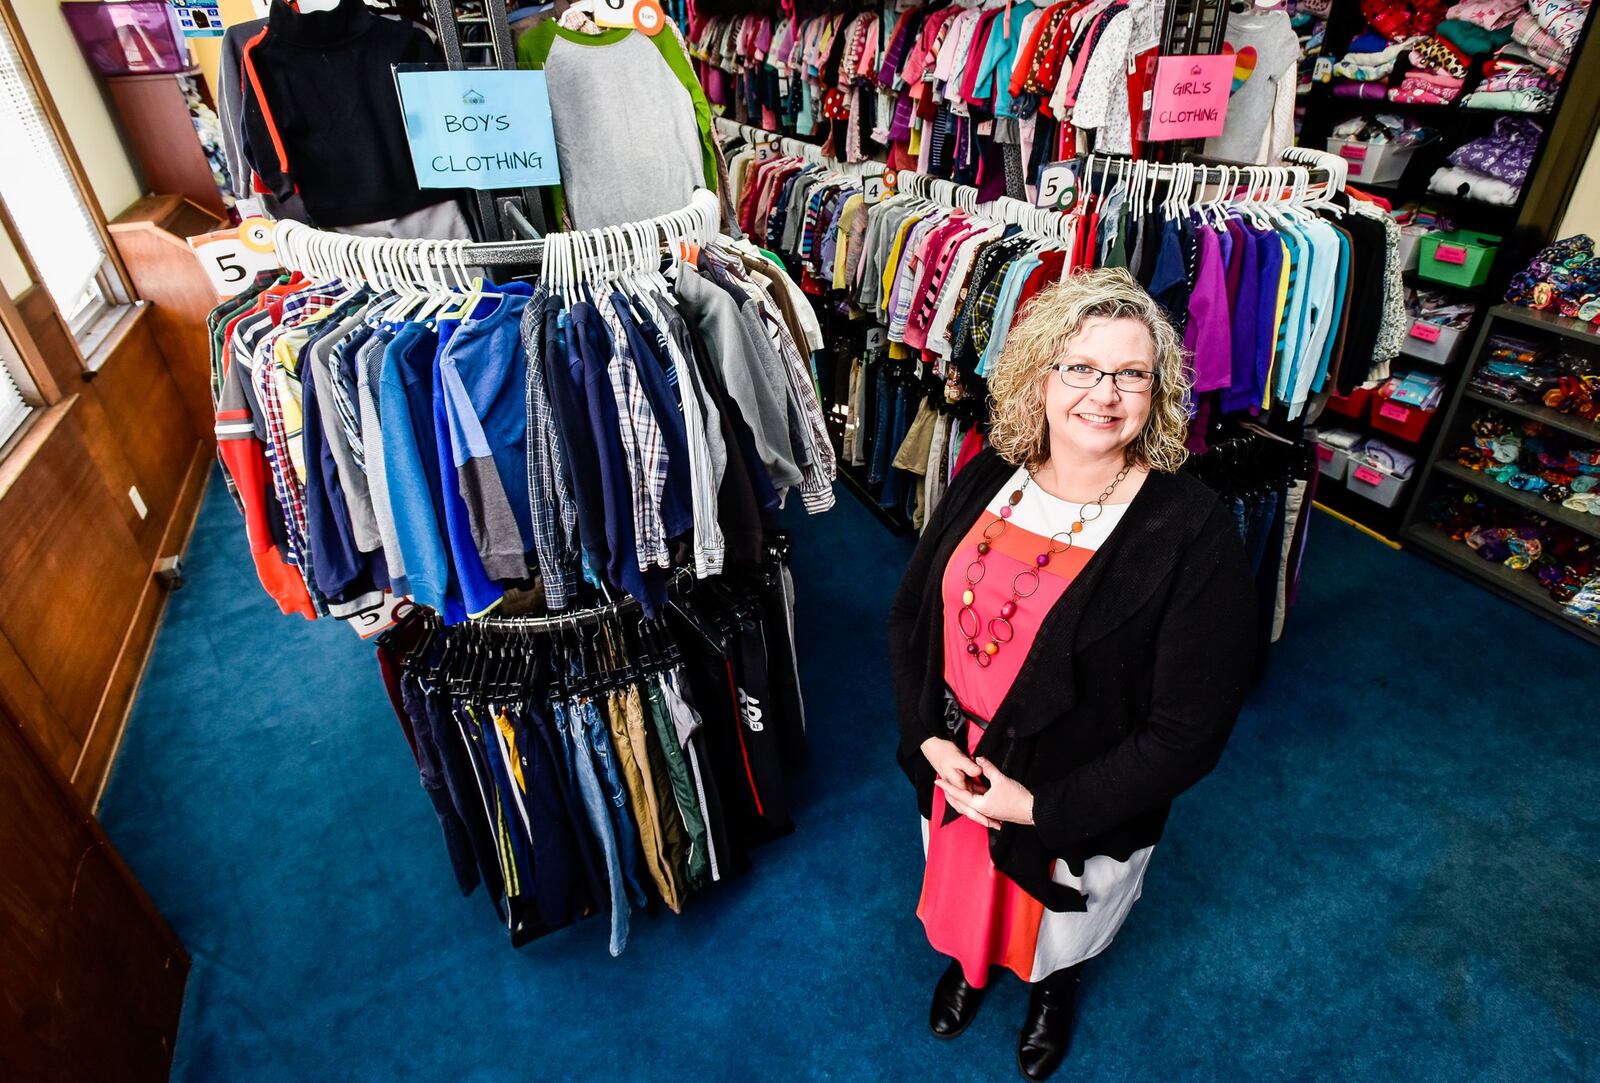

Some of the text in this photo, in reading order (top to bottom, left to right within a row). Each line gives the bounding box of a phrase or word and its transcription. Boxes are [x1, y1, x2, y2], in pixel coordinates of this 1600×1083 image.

[1172, 81, 1212, 96] GIRL'S
[444, 114, 510, 133] BOY'S
[1159, 108, 1218, 124] CLOTHING
[432, 151, 543, 172] CLOTHING
[759, 149, 767, 160] 3
[868, 183, 879, 198] 4
[1044, 176, 1059, 197] 5
[254, 229, 264, 240] 6
[216, 253, 247, 283] 5
[870, 332, 880, 344] 4
